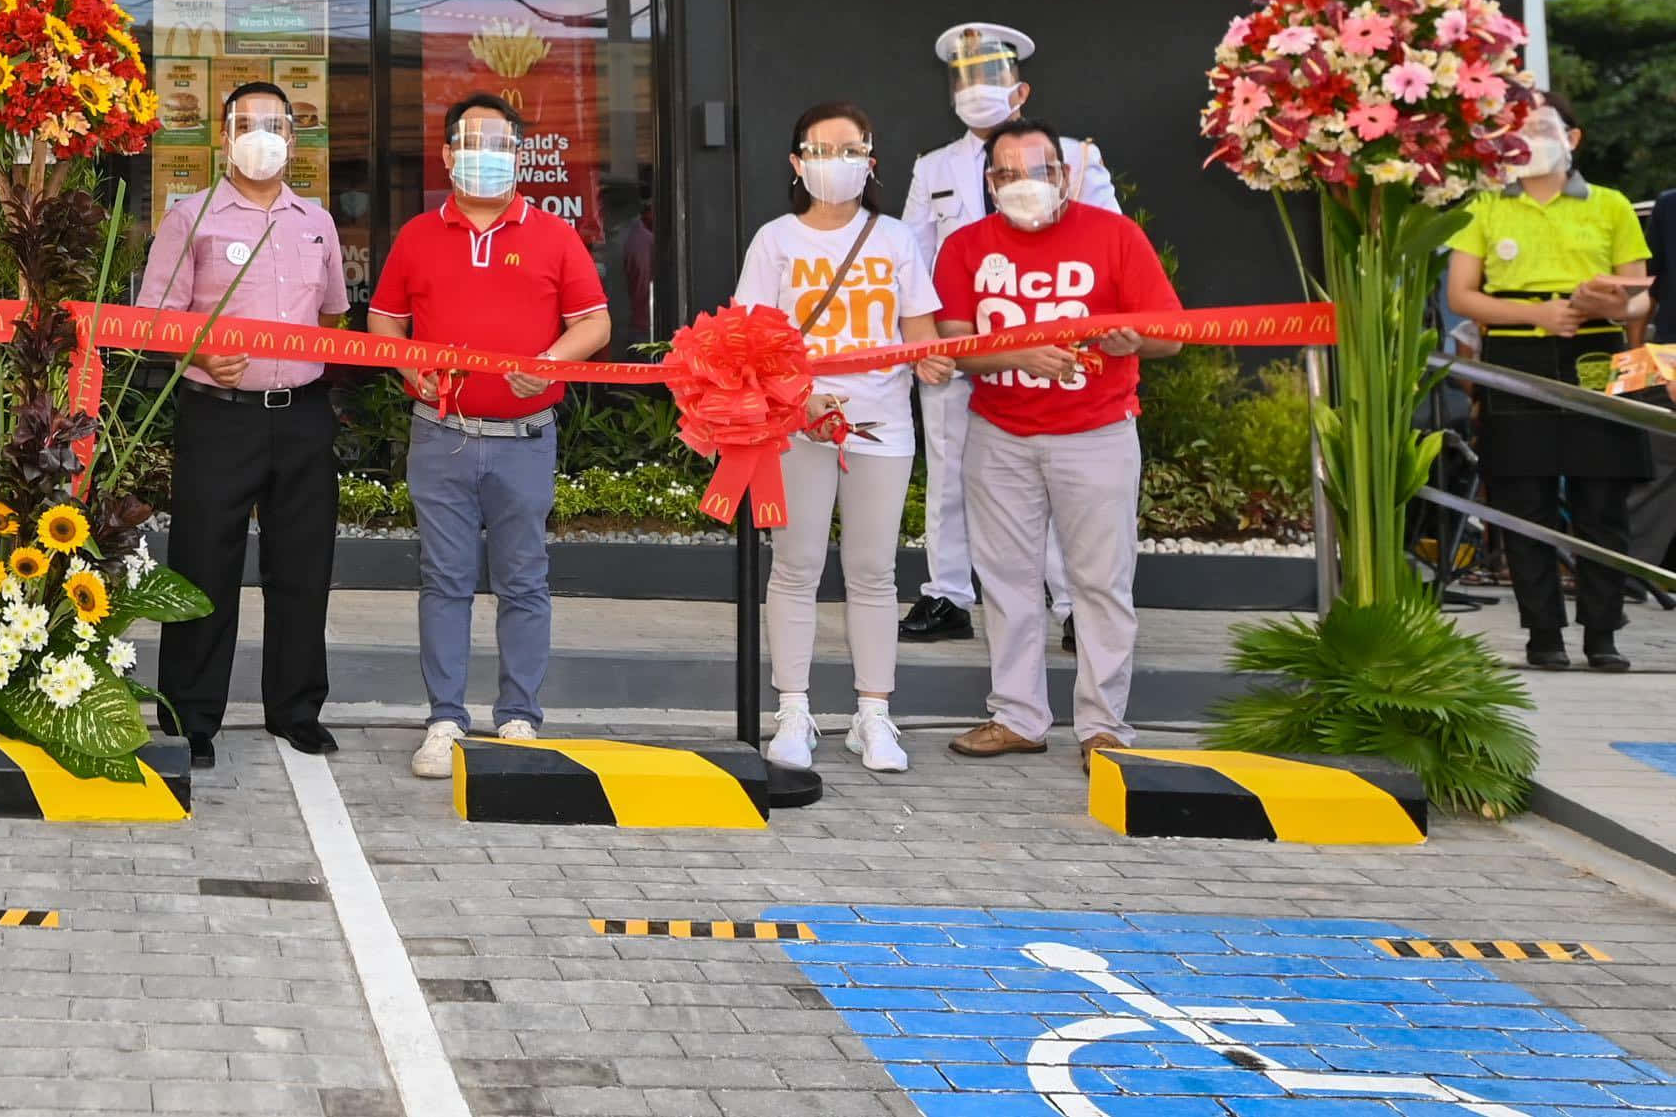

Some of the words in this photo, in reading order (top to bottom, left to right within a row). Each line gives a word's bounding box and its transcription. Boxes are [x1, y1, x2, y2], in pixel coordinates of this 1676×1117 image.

[521, 150, 566, 166] Blvd.
[516, 167, 570, 183] Wack
[541, 196, 583, 217] ON
[791, 257, 894, 288] McD
[975, 261, 1095, 299] McD
